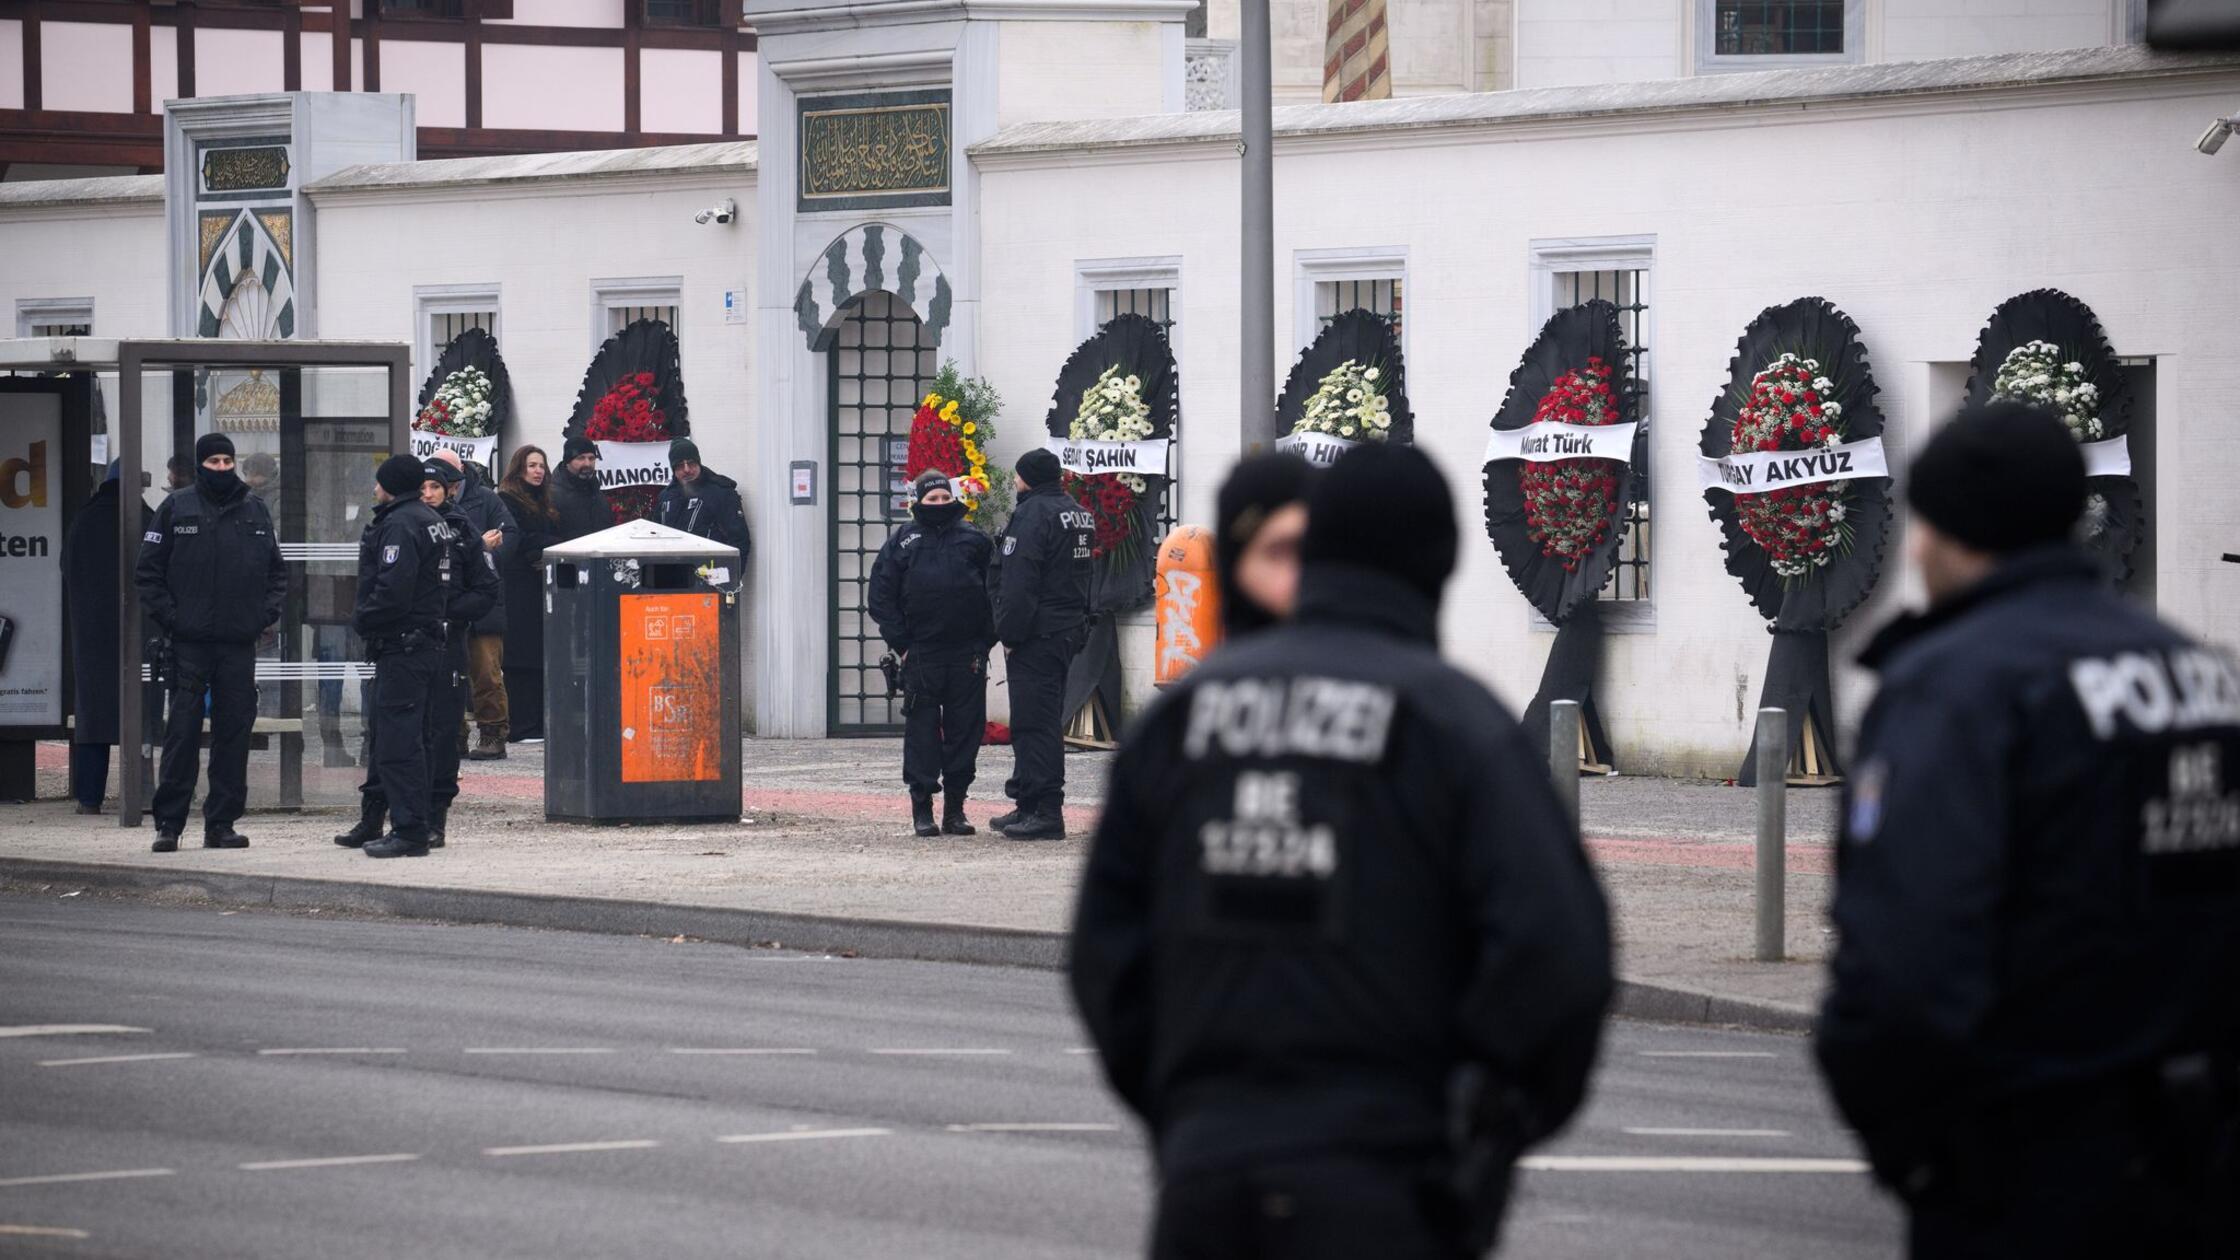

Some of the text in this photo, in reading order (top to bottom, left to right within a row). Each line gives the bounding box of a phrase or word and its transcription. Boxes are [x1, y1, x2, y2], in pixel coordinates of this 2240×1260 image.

[1085, 442, 1136, 472] ŞAHİN
[1520, 433, 1594, 455] Murat Türk
[1766, 449, 1853, 483] AKYÜZ
[173, 526, 198, 535] POLIZEI
[1184, 677, 1396, 764] POLIZEI
